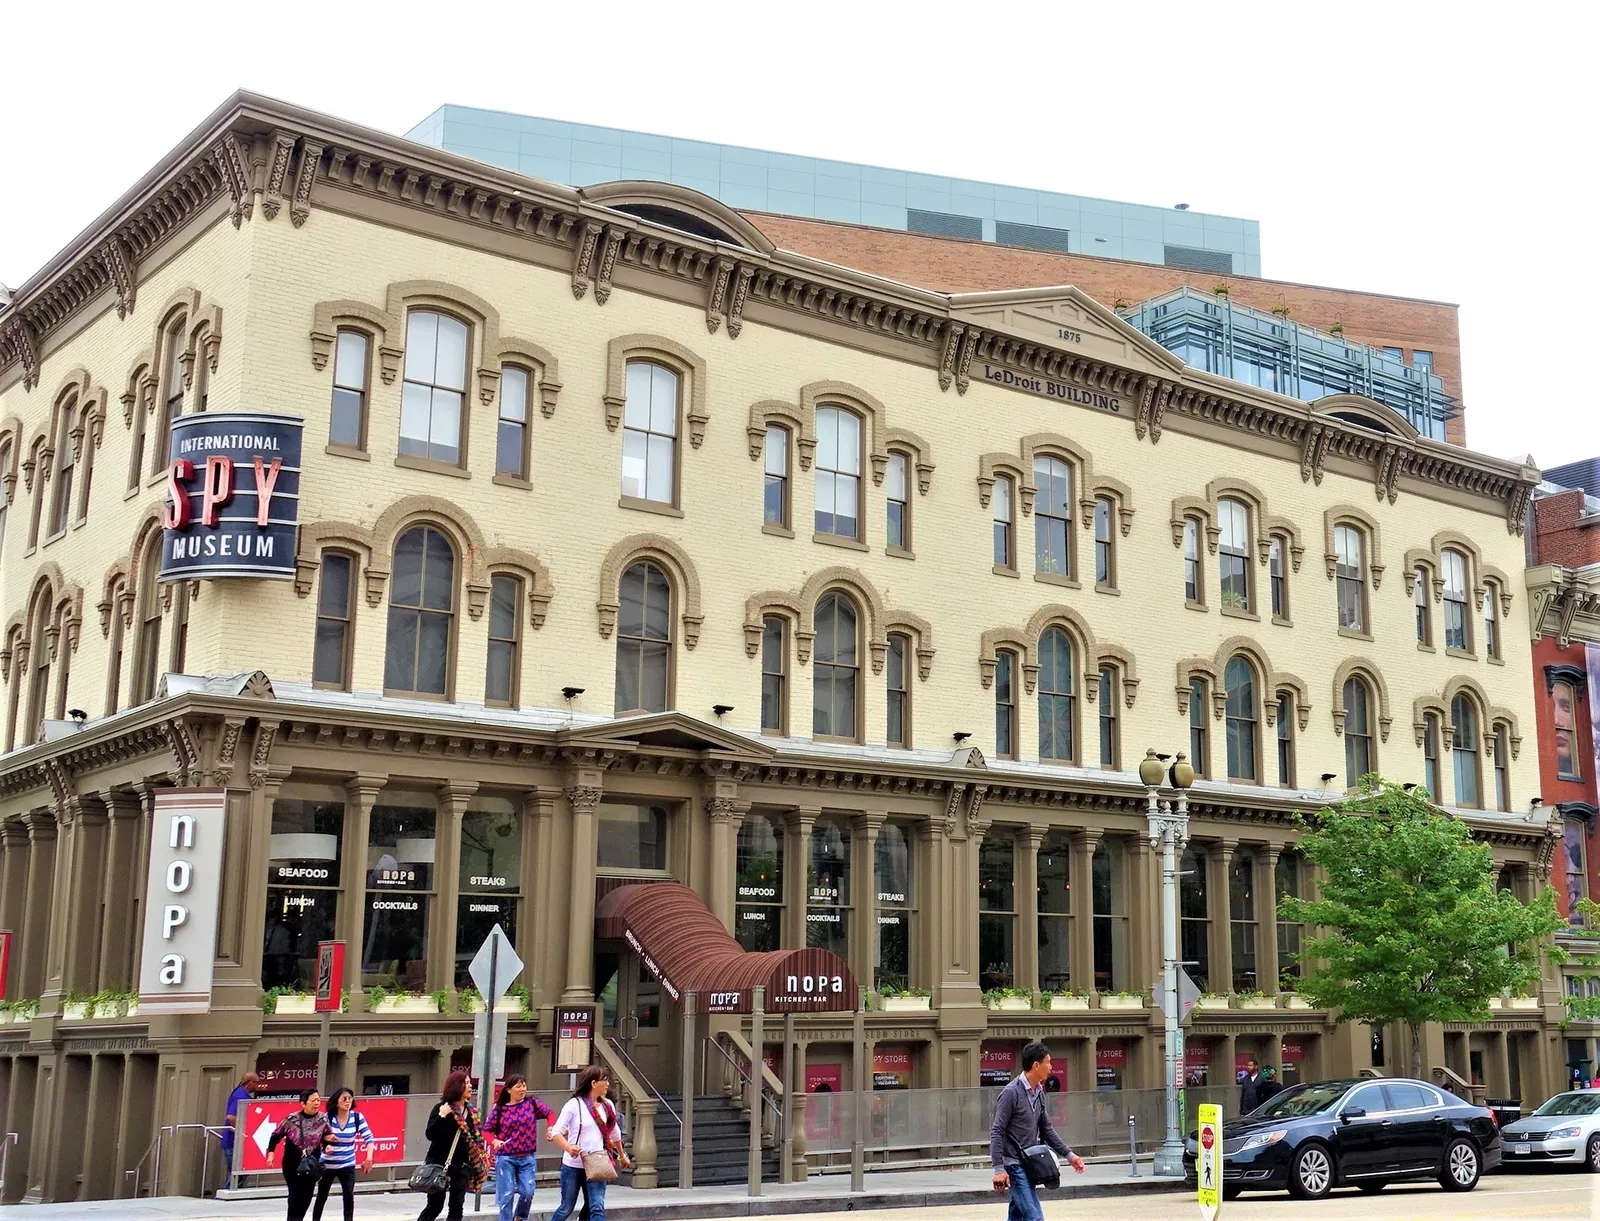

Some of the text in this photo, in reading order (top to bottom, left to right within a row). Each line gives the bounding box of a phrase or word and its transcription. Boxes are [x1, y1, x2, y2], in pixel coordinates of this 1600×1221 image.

[1058, 329, 1081, 343] 1875
[984, 365, 1120, 412] LeDroit BUILDING
[181, 434, 280, 454] INTERNATIONAL
[165, 455, 283, 530] SPY
[172, 534, 274, 560] MUSEUM
[278, 867, 328, 879] SEAFOOD
[470, 875, 506, 886] STEAKS
[739, 887, 775, 897] SEAFOOD
[877, 892, 905, 902] STEAKS
[286, 897, 315, 907] LUNCH
[372, 901, 418, 910] COCKTAILS
[469, 904, 499, 913] DINNER
[743, 912, 766, 921] LUNCH
[807, 914, 840, 922] COCKTAILS
[877, 917, 900, 925] DINNER
[645, 955, 660, 976] LUNCH
[662, 977, 680, 1001] DINNER
[277, 1034, 472, 1047] INTERATIONAL SPY MUSEUM
[980, 1052, 1012, 1061] PY STORE
[1104, 1050, 1123, 1058] STORE
[1190, 1048, 1209, 1056] STORE
[873, 1055, 908, 1063] PY STORE
[284, 1069, 319, 1079] STORE
[1574, 1069, 1580, 1078] P
[1202, 1133, 1214, 1143] STOP
[360, 1144, 378, 1152] CN
[379, 1143, 398, 1151] BUY
